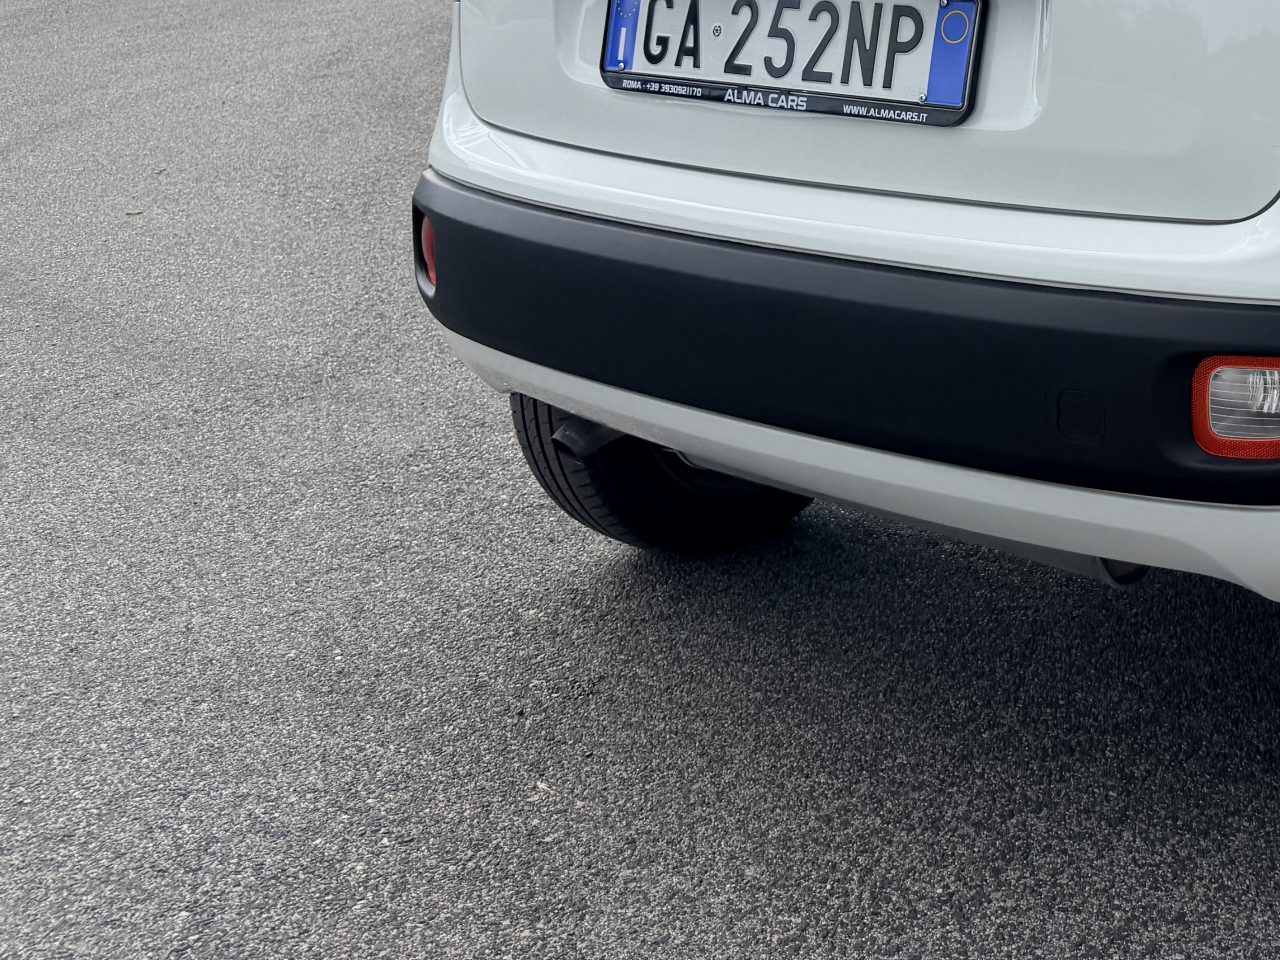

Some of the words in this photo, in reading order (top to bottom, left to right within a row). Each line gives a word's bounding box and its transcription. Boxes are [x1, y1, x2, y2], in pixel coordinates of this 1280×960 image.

[622, 79, 642, 90] ROMA
[723, 88, 765, 106] ALMA
[768, 93, 808, 111] CARS
[843, 104, 928, 122] WWW.ALMACARS.IT
